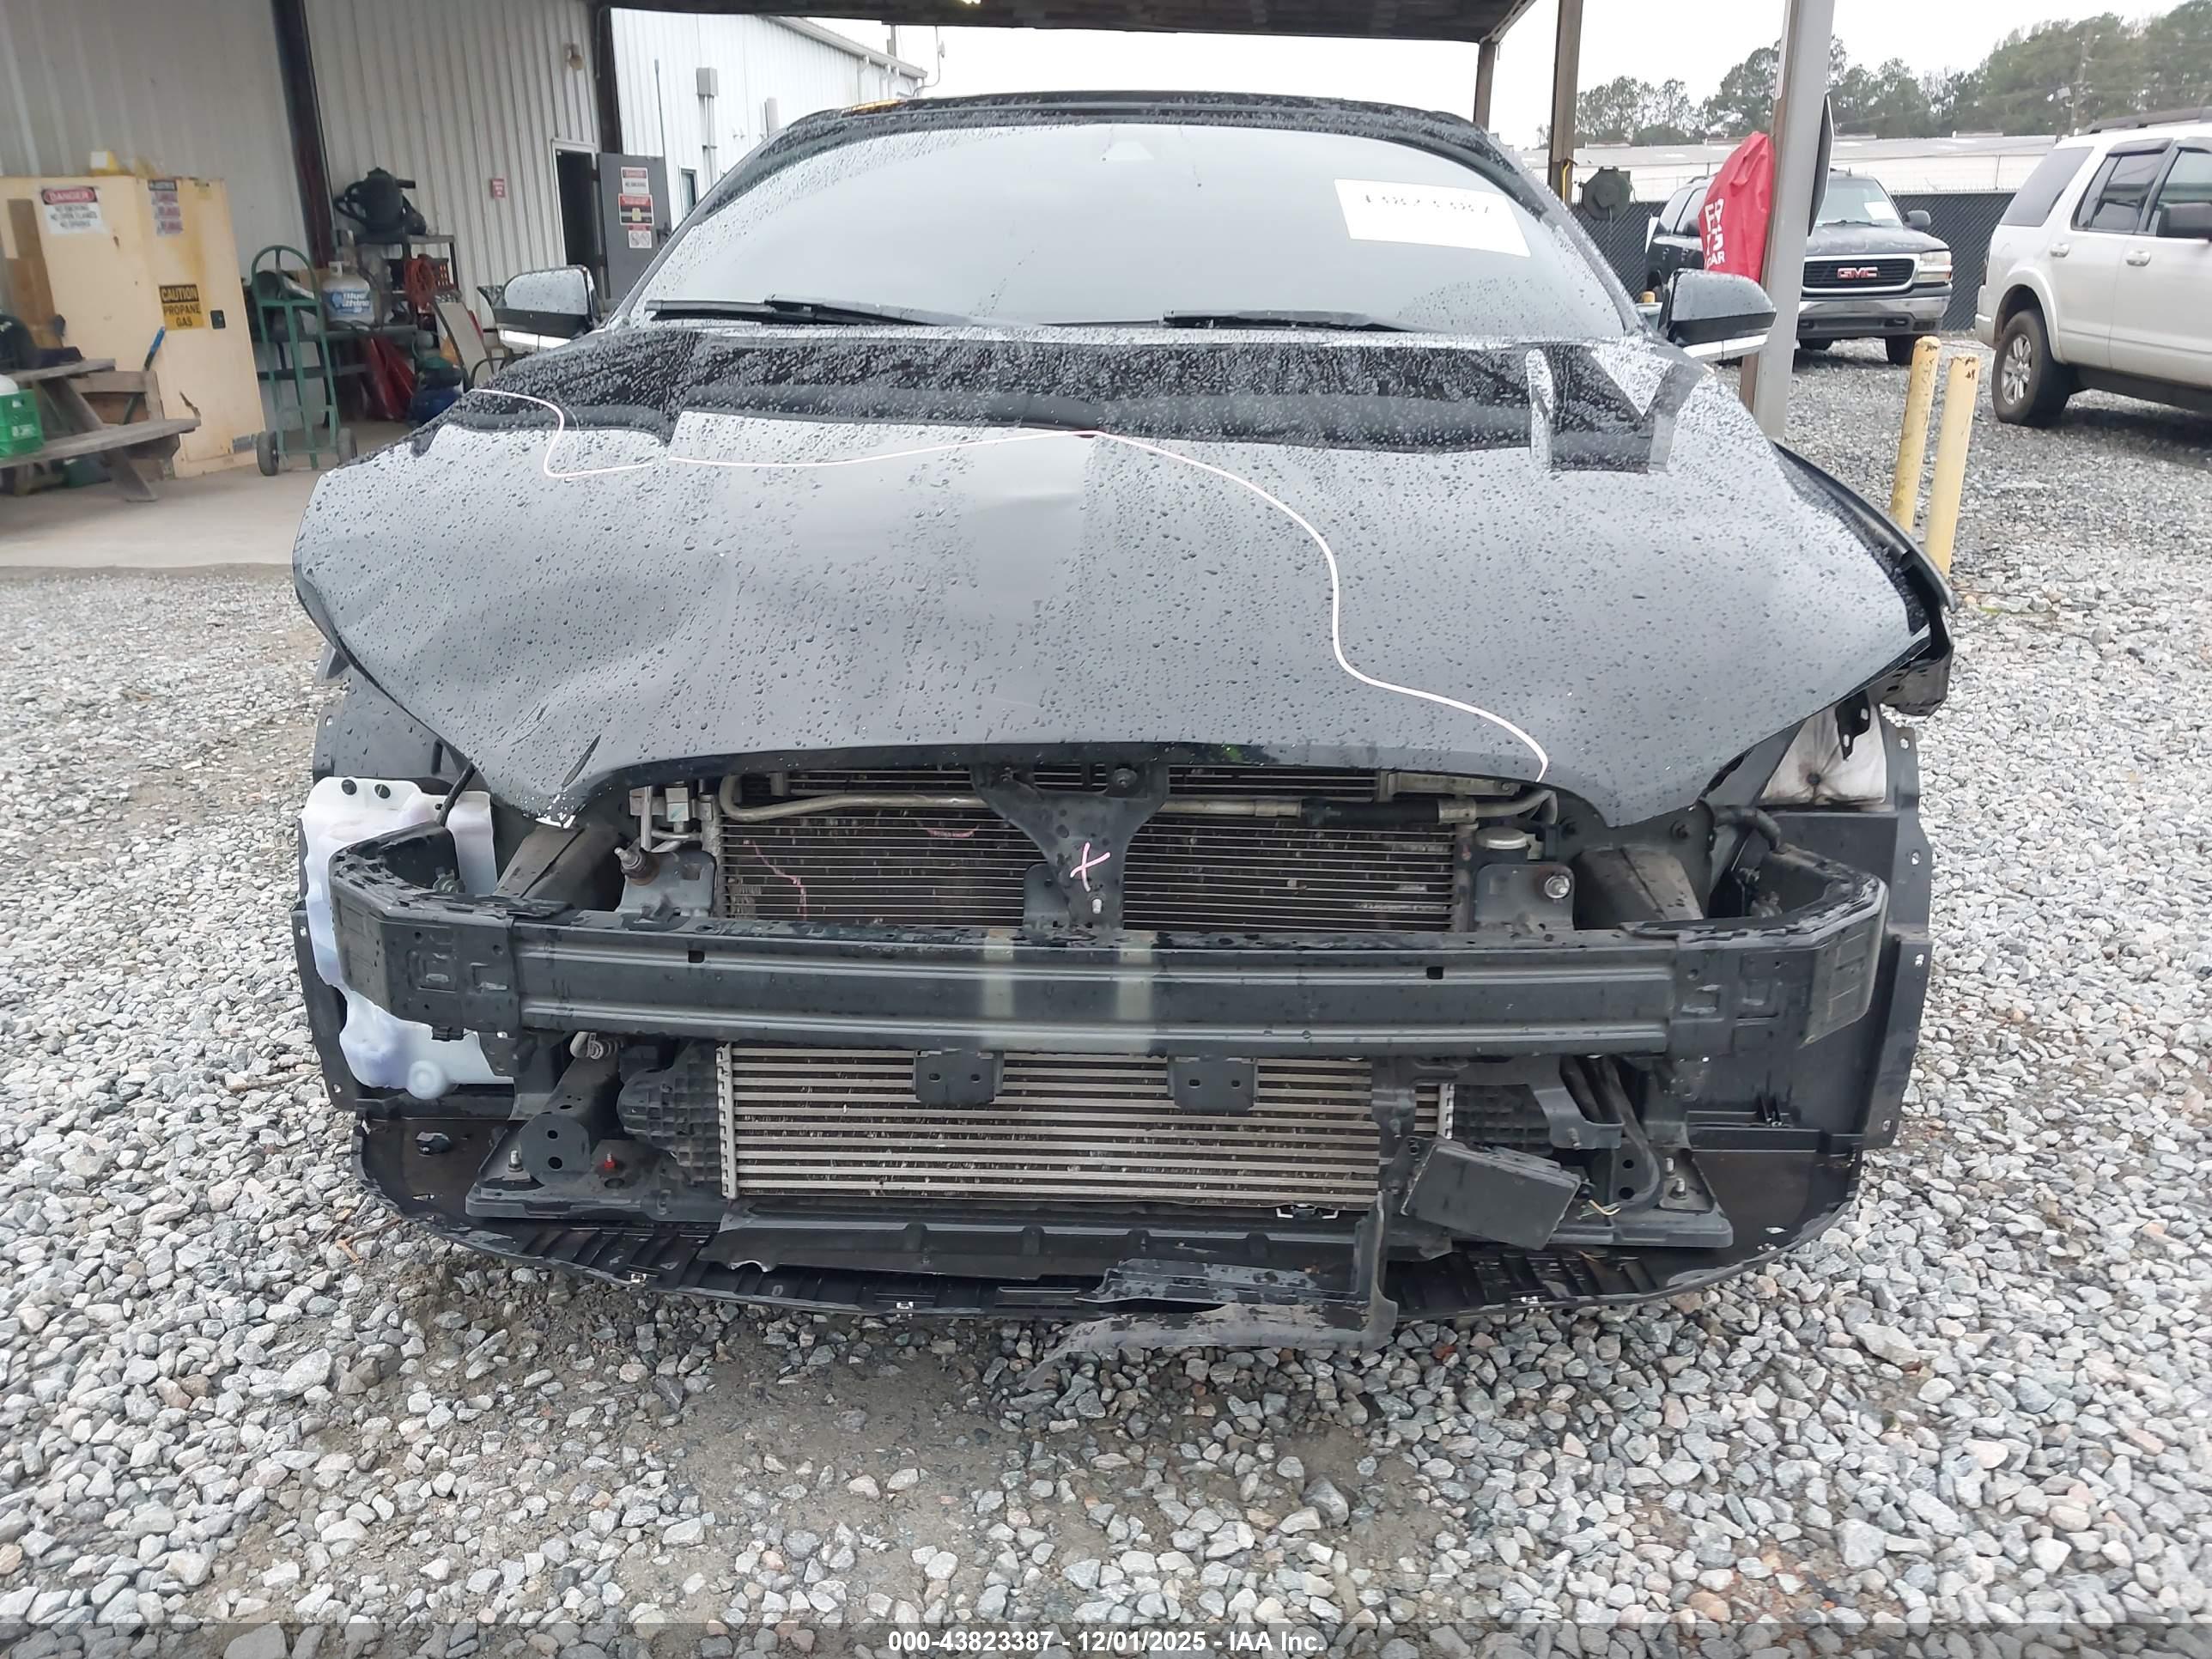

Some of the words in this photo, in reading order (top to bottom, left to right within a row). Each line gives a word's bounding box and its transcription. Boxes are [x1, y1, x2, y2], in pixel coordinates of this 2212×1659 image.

[49, 191, 89, 201] DANGER
[1838, 266, 1879, 279] GMC
[162, 287, 198, 301] CAUTION
[163, 303, 201, 316] PROPANE
[176, 316, 192, 326] GAS
